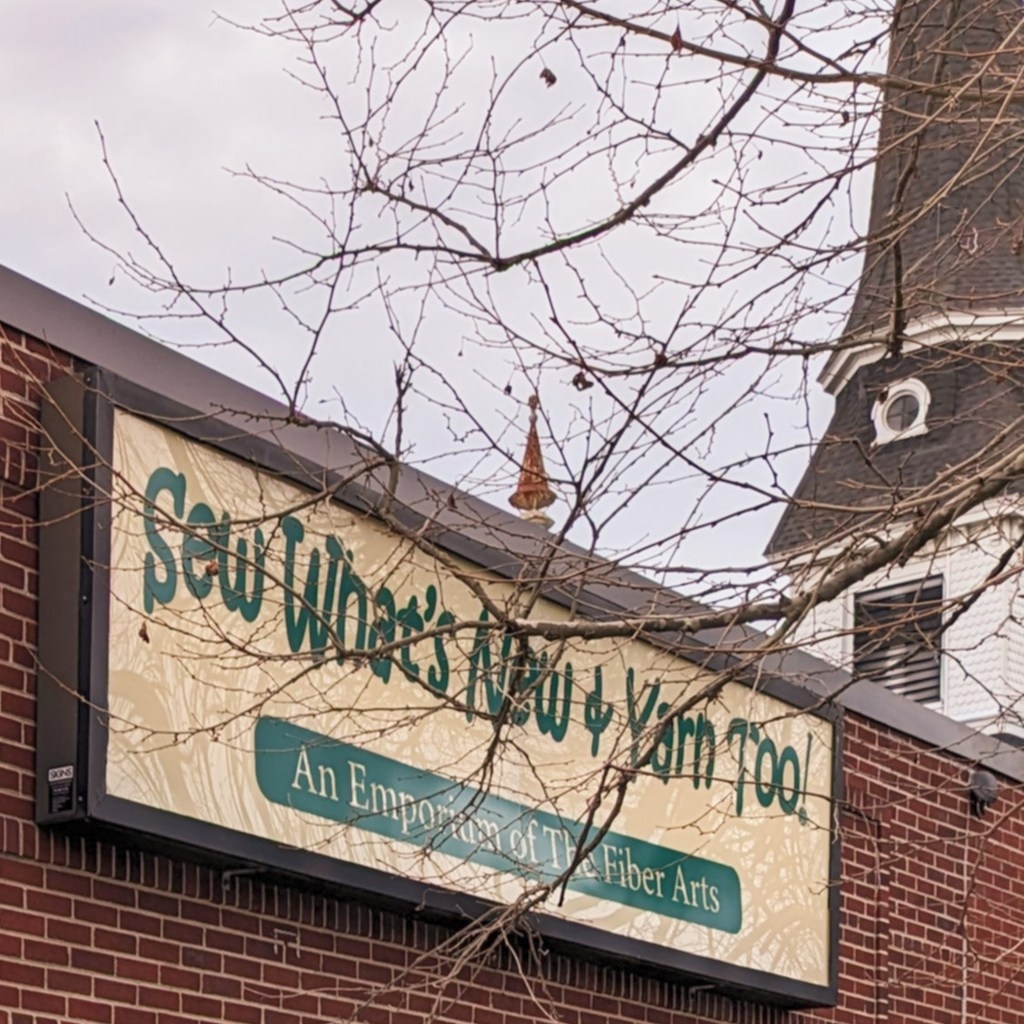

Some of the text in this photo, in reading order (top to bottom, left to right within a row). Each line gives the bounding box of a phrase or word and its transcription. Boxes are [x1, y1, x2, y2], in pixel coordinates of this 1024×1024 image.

[143, 467, 265, 623] Sew
[282, 515, 455, 699] What's
[466, 609, 572, 742] New
[627, 667, 715, 790] Yarn
[292, 746, 720, 913] An Emporium of The Fiber Arts
